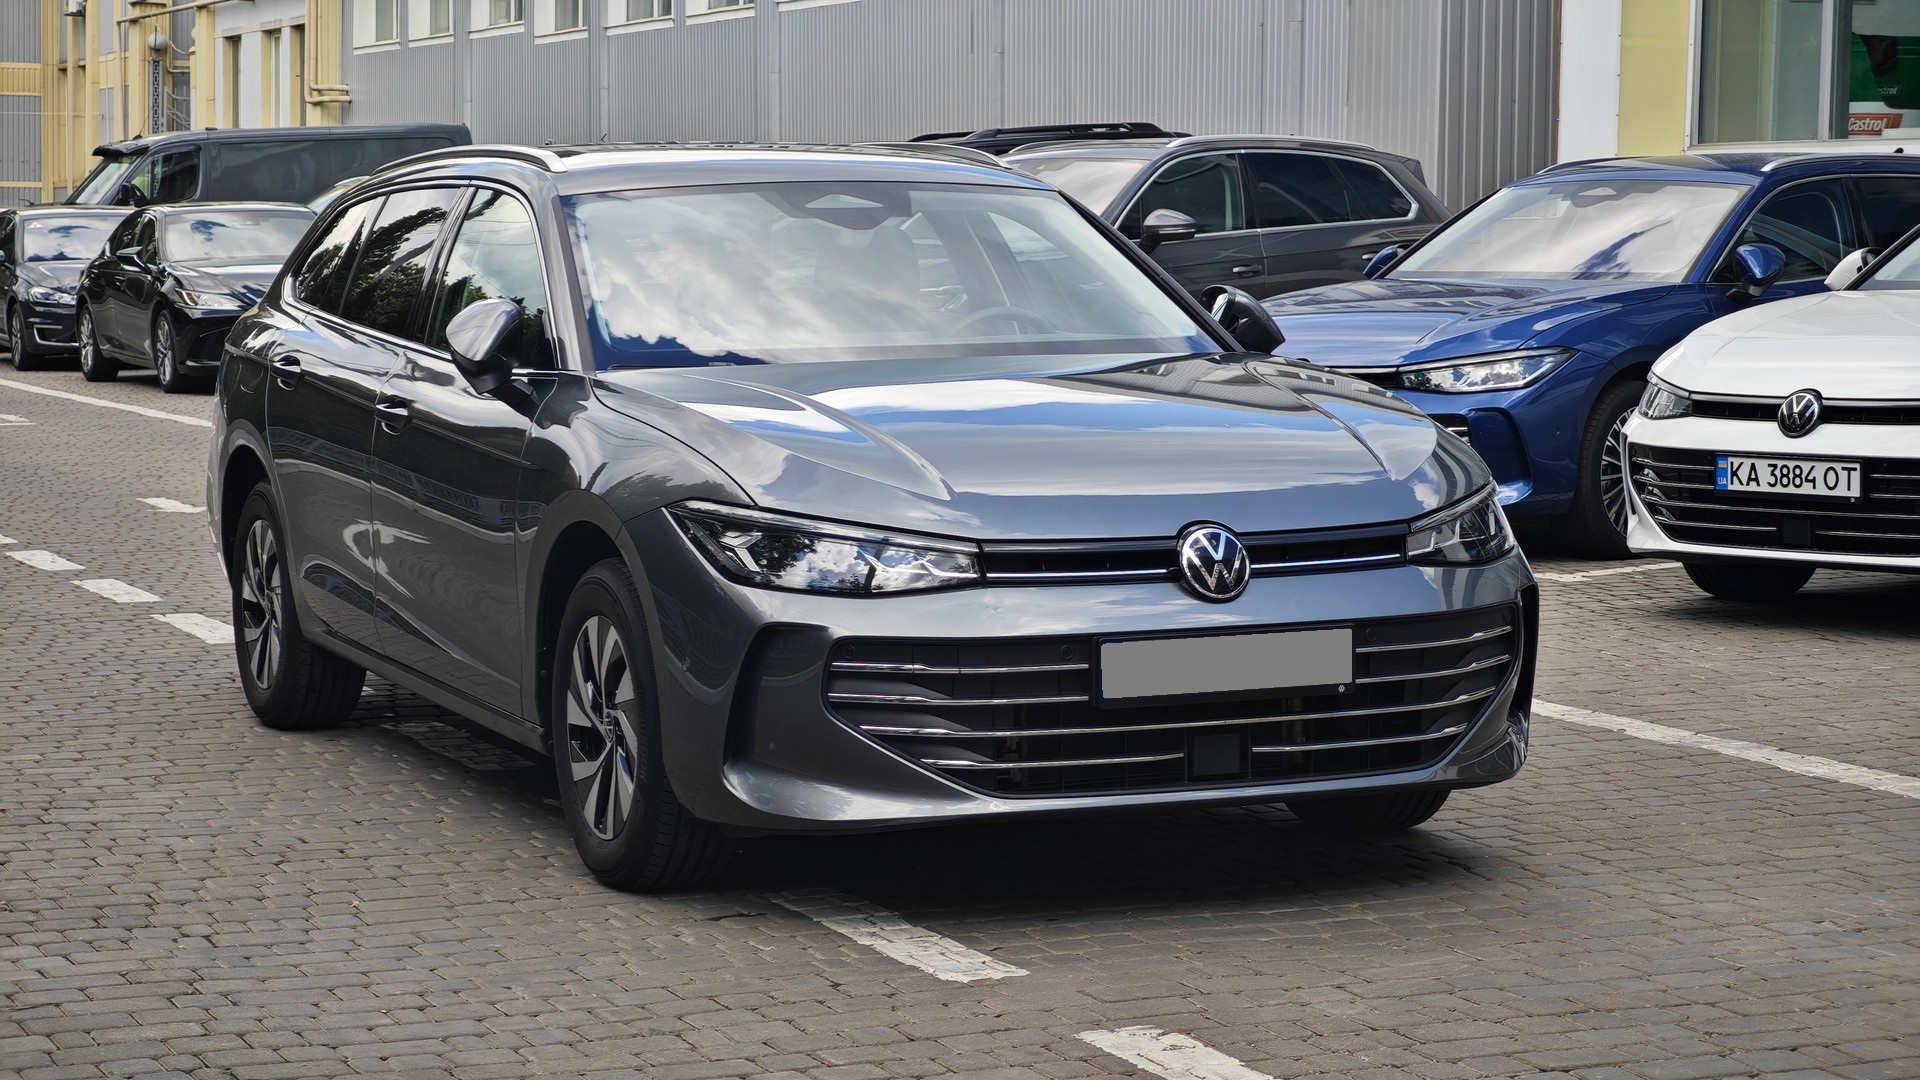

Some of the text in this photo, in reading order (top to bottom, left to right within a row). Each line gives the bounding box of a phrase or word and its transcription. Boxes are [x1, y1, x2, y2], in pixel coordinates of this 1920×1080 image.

[1877, 86, 1898, 95] strol
[1848, 117, 1887, 131] Castrol
[1717, 476, 1728, 485] UA
[1730, 461, 1858, 491] KA 3884 OT
[1182, 528, 1249, 598] VW
